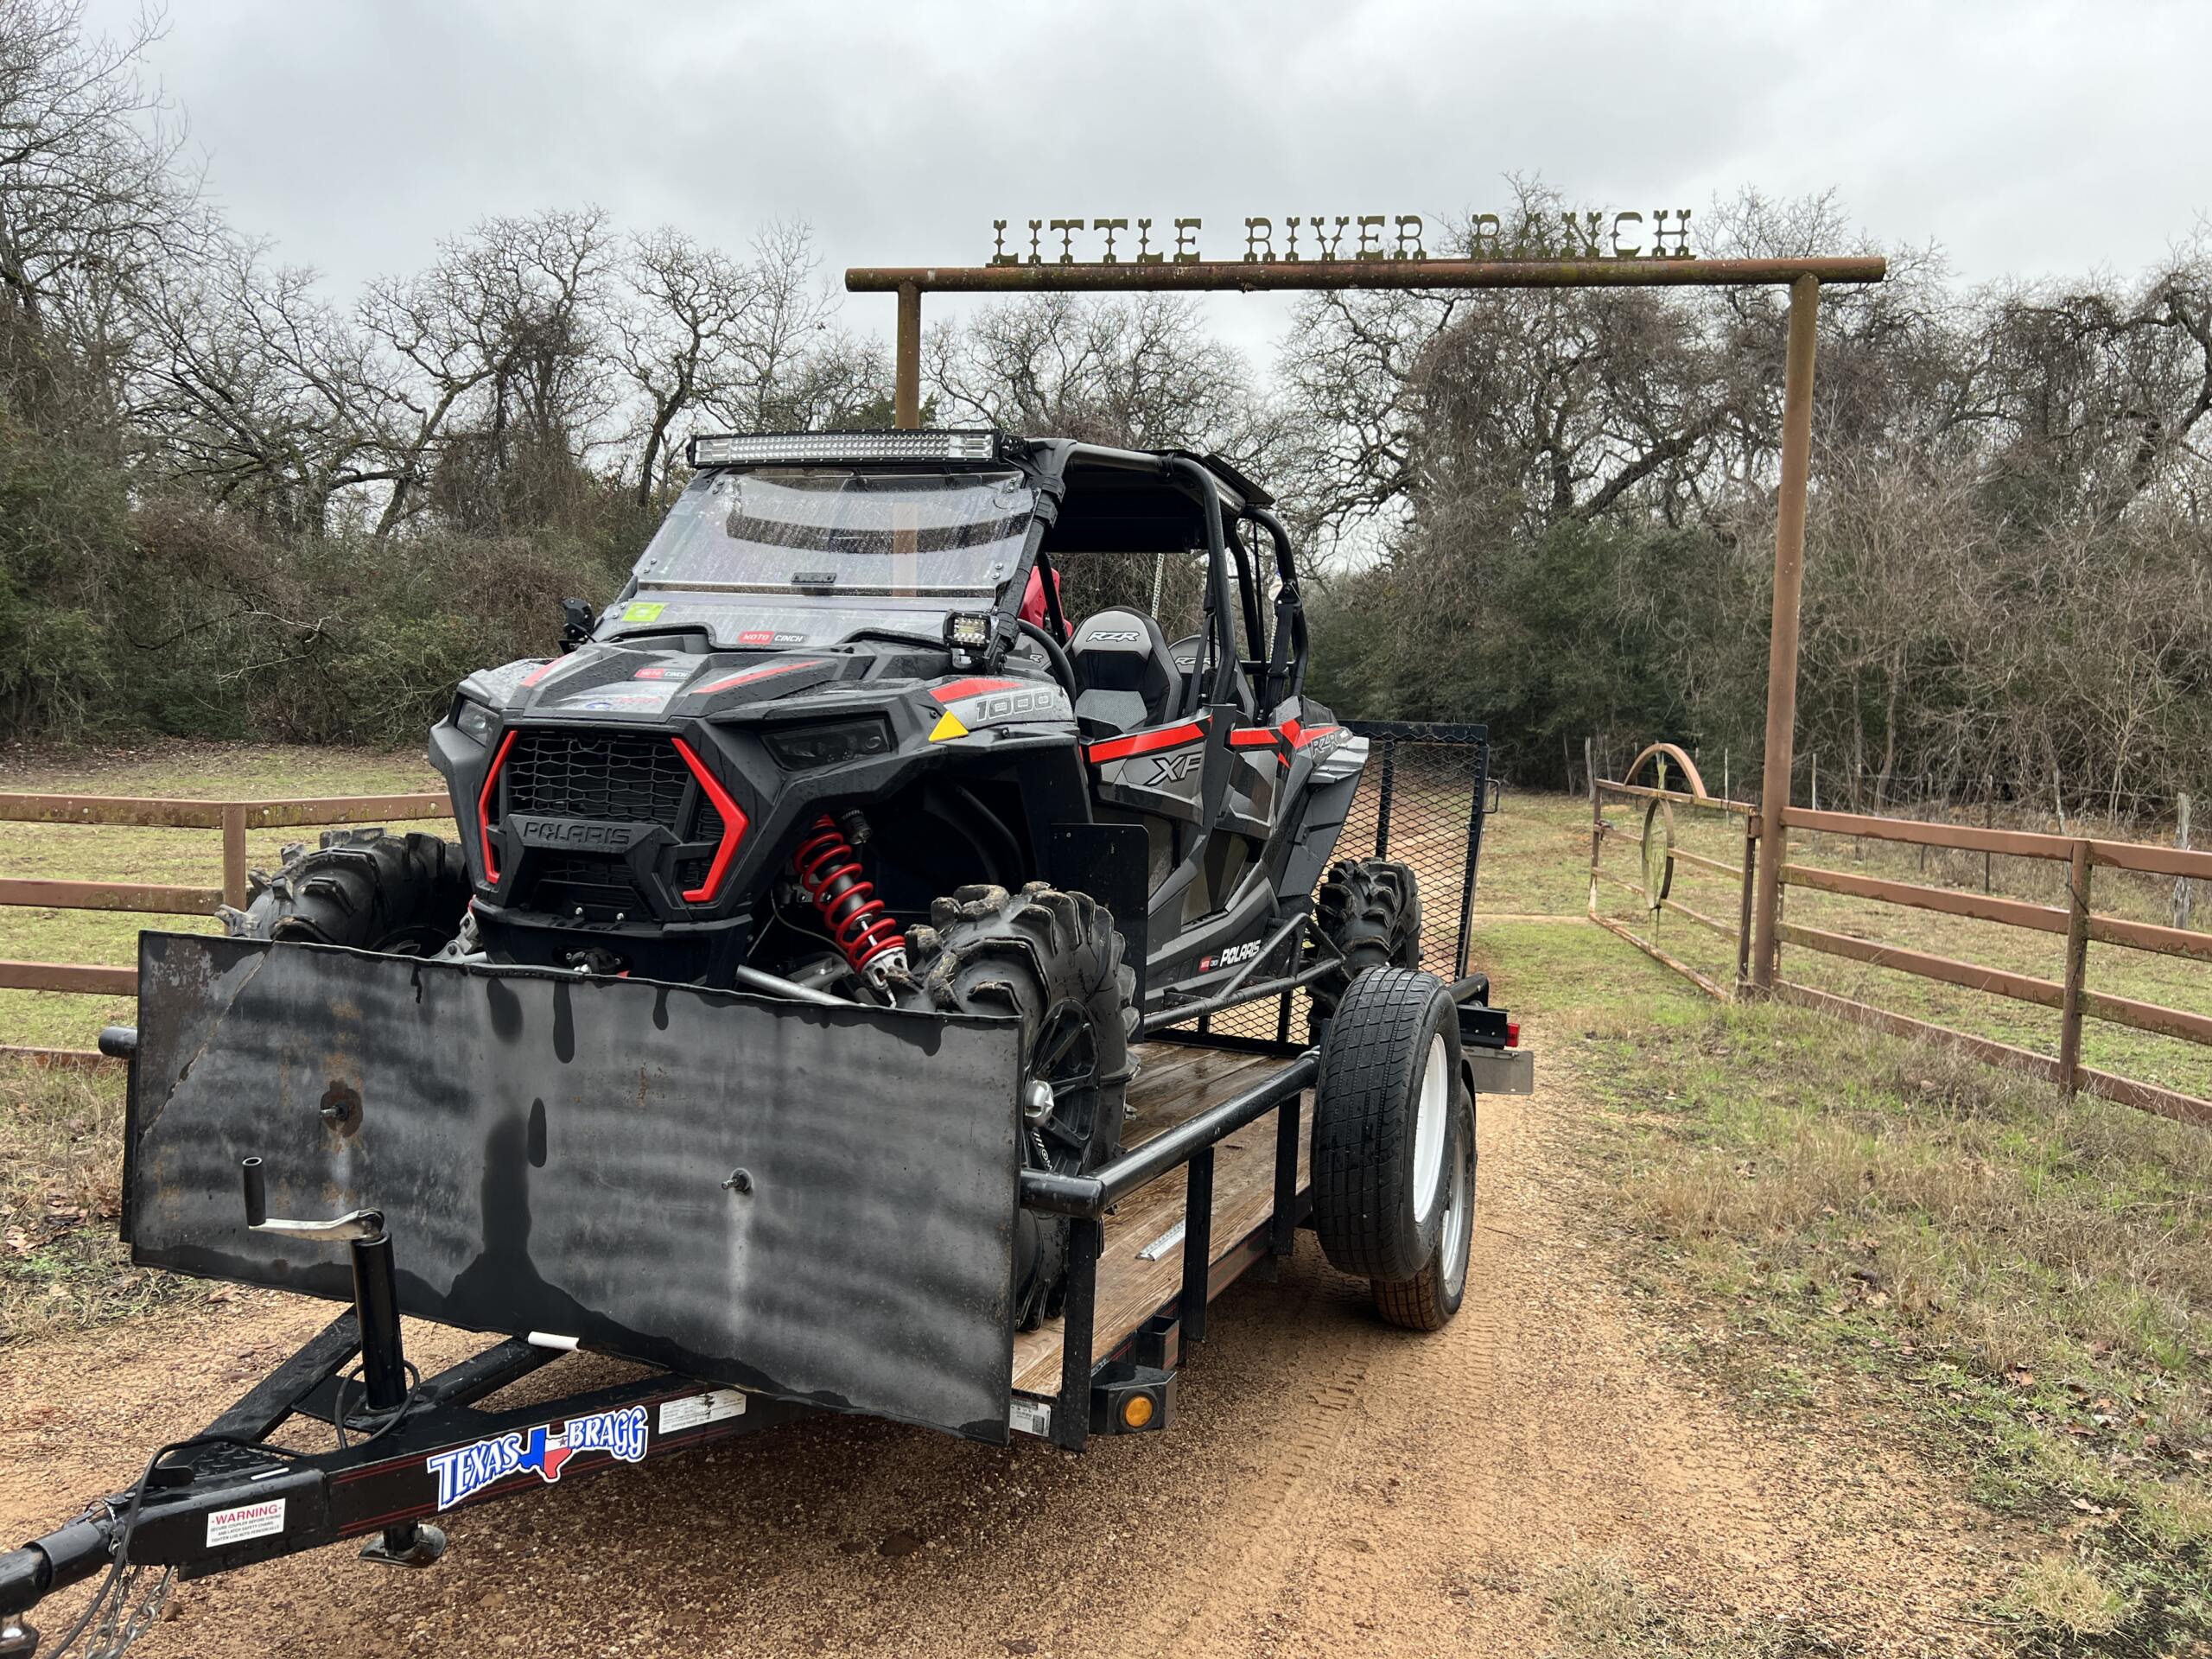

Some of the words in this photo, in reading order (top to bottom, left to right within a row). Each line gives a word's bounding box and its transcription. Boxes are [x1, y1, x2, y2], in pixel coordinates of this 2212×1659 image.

[993, 219, 1202, 264] LITTLE
[1244, 215, 1427, 263] RIVER
[1471, 210, 1693, 258] RANCH
[743, 633, 771, 642] MOTO
[1086, 631, 1140, 642] RZR
[976, 691, 1054, 722] 1000
[523, 822, 632, 845] POLARIS
[1219, 939, 1262, 967] POLARIS
[434, 1435, 521, 1508] TEXAS
[567, 1408, 646, 1459] BRAGG
